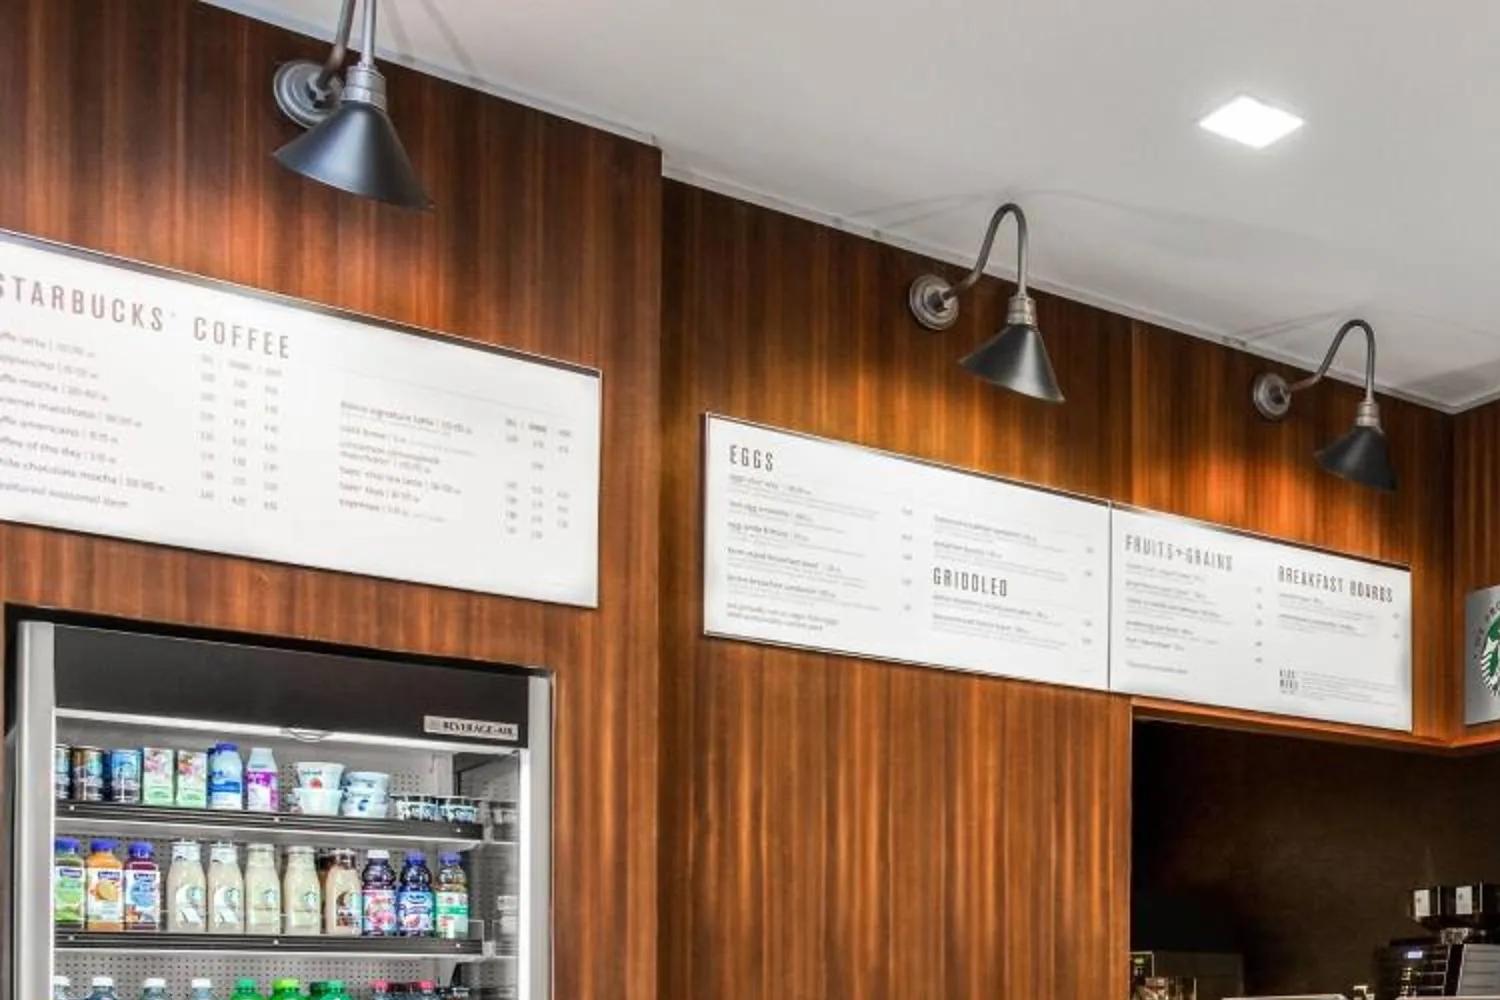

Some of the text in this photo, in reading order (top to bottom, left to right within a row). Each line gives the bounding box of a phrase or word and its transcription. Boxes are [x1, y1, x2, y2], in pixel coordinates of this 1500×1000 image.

[194, 316, 289, 359] COFFEE
[729, 444, 773, 472] EGGS
[933, 567, 1008, 597] GRIDDLED
[1278, 565, 1393, 603] BREAKFAST BOARDS
